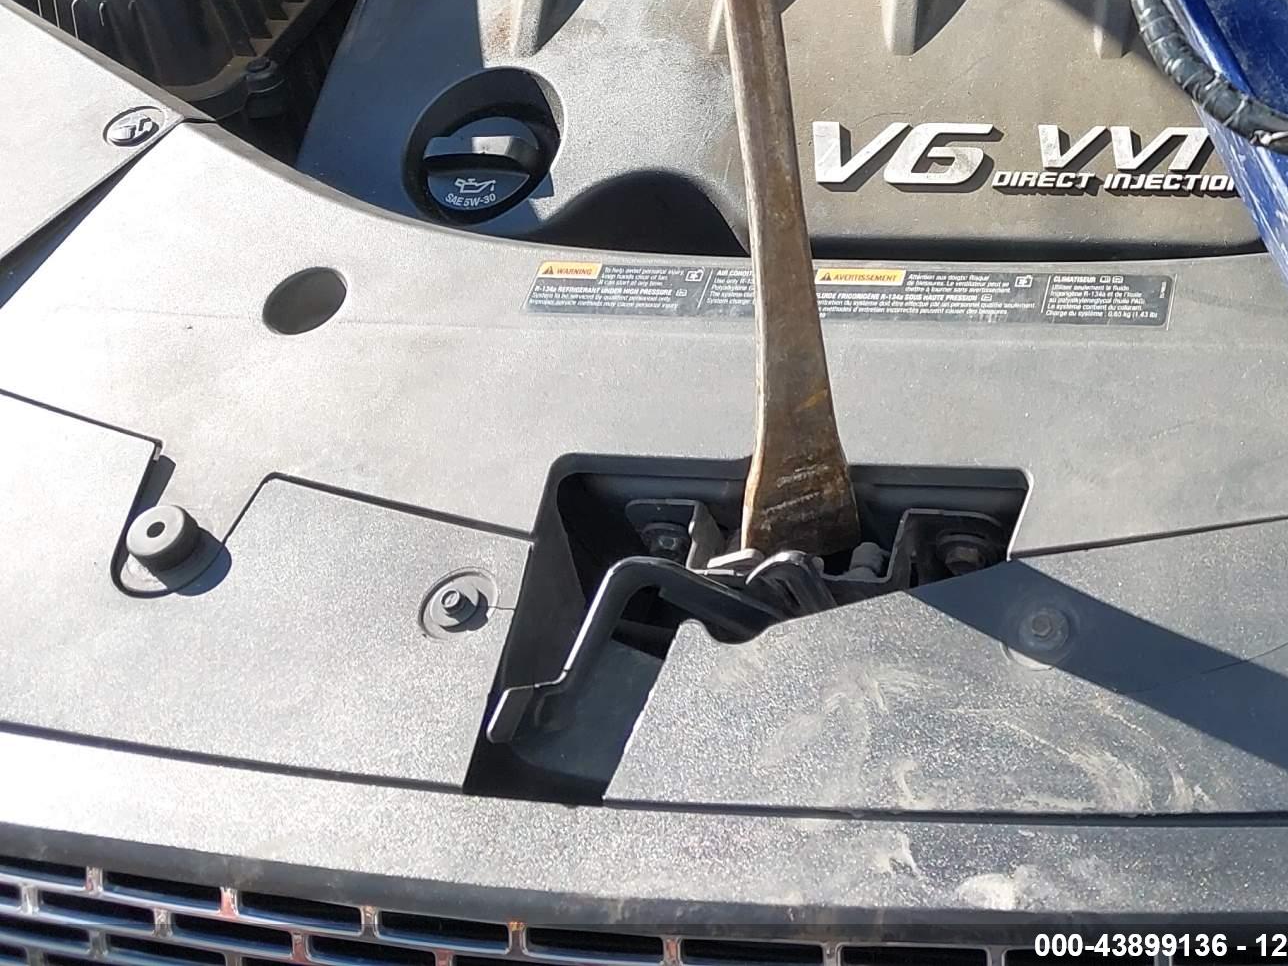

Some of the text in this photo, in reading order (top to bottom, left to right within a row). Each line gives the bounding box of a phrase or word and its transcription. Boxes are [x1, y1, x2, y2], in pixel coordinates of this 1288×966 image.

[812, 121, 994, 184] V6
[991, 171, 1096, 189] DIRECT
[445, 193, 496, 207] SAE 5W-30
[557, 267, 593, 275] WARNING
[833, 274, 897, 282] AVERTISSEMENT
[1053, 275, 1097, 283] CLIMATISEUR
[557, 286, 601, 294] REFRIGERANT
[639, 288, 673, 296] PRESSURE
